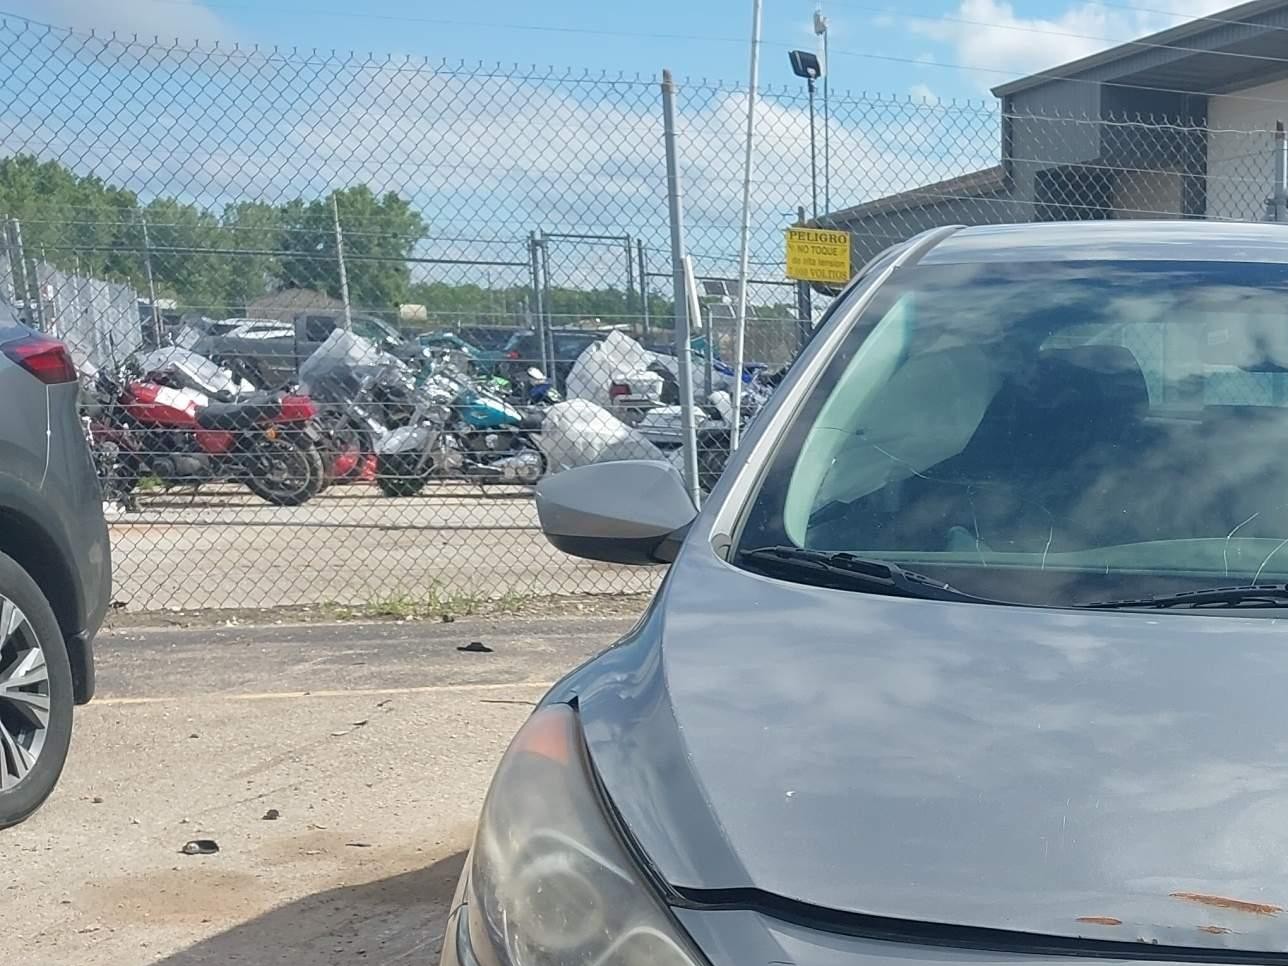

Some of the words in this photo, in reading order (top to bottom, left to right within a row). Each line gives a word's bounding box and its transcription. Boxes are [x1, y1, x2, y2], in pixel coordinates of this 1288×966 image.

[790, 231, 847, 244] PELIGRO
[797, 244, 809, 254] NO
[811, 245, 838, 256] TOQUE
[810, 268, 847, 280] VOLTIOS
